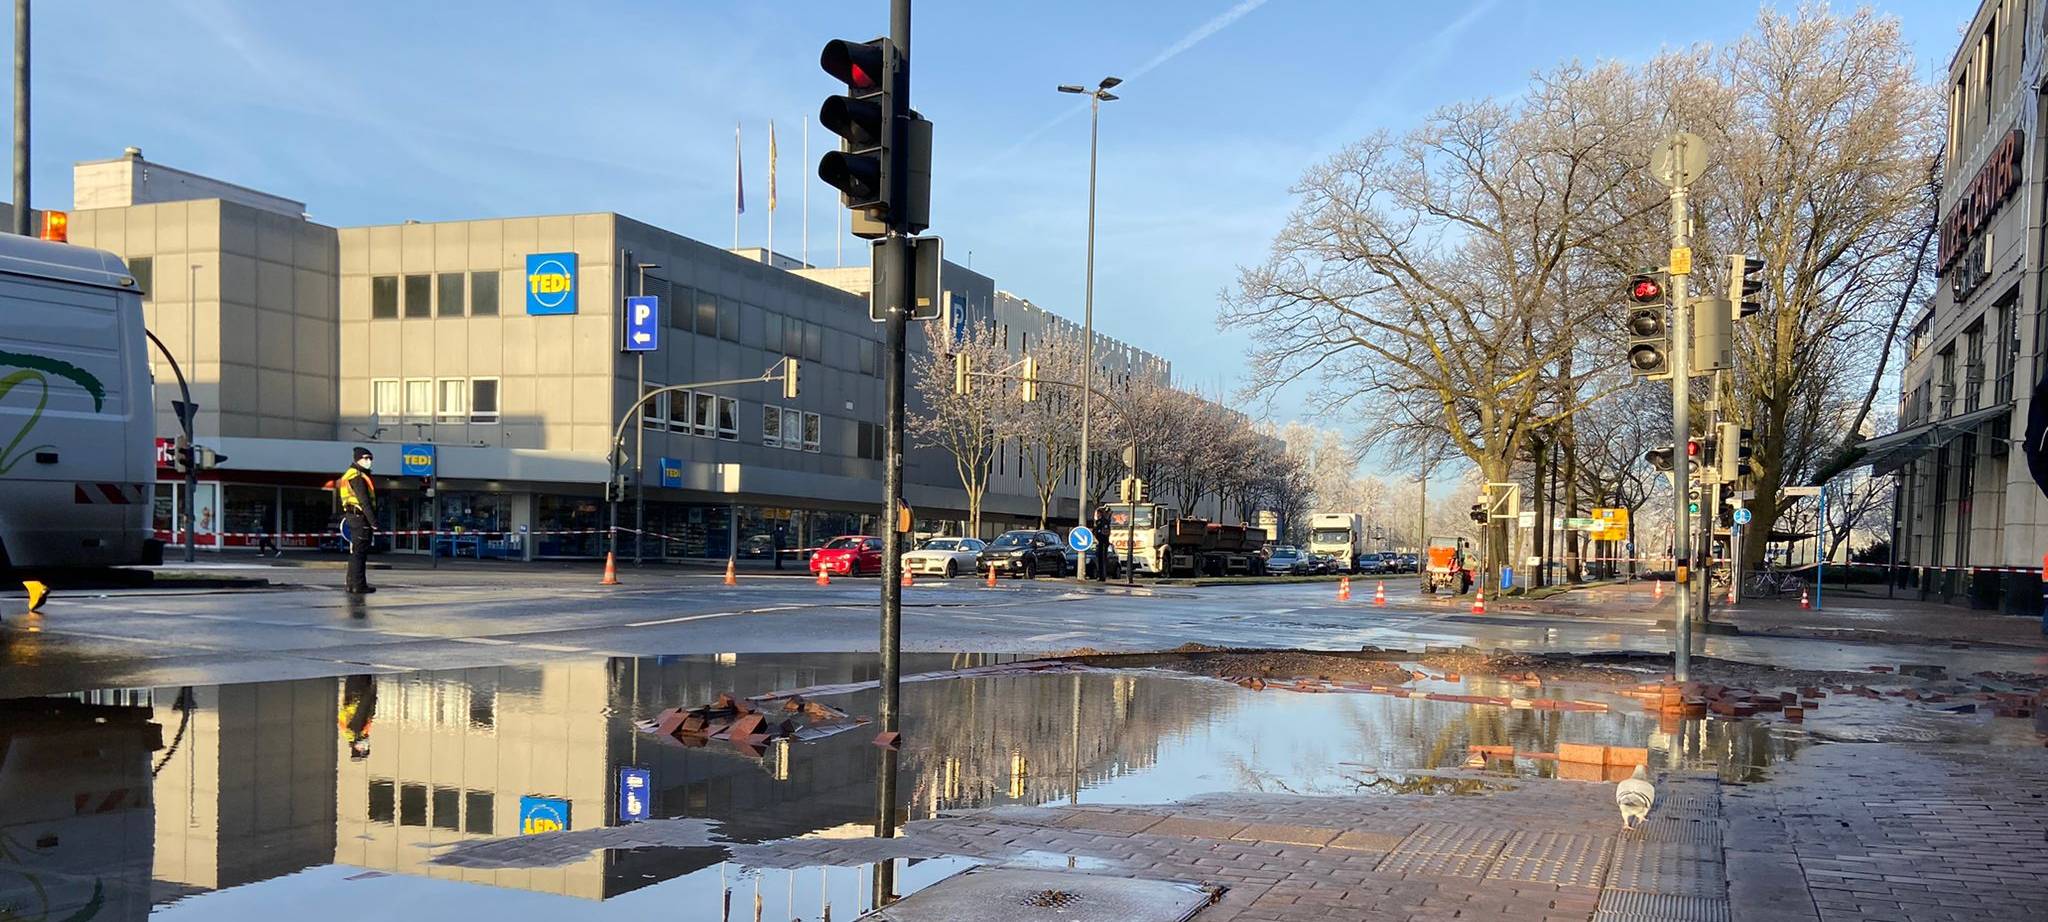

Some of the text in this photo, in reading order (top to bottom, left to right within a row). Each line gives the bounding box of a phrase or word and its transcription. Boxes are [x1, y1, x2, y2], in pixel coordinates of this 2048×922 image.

[528, 273, 571, 294] TEDi
[635, 304, 650, 326] P
[954, 303, 964, 328] P
[403, 455, 432, 466] TEDi
[666, 468, 680, 478] TEDi
